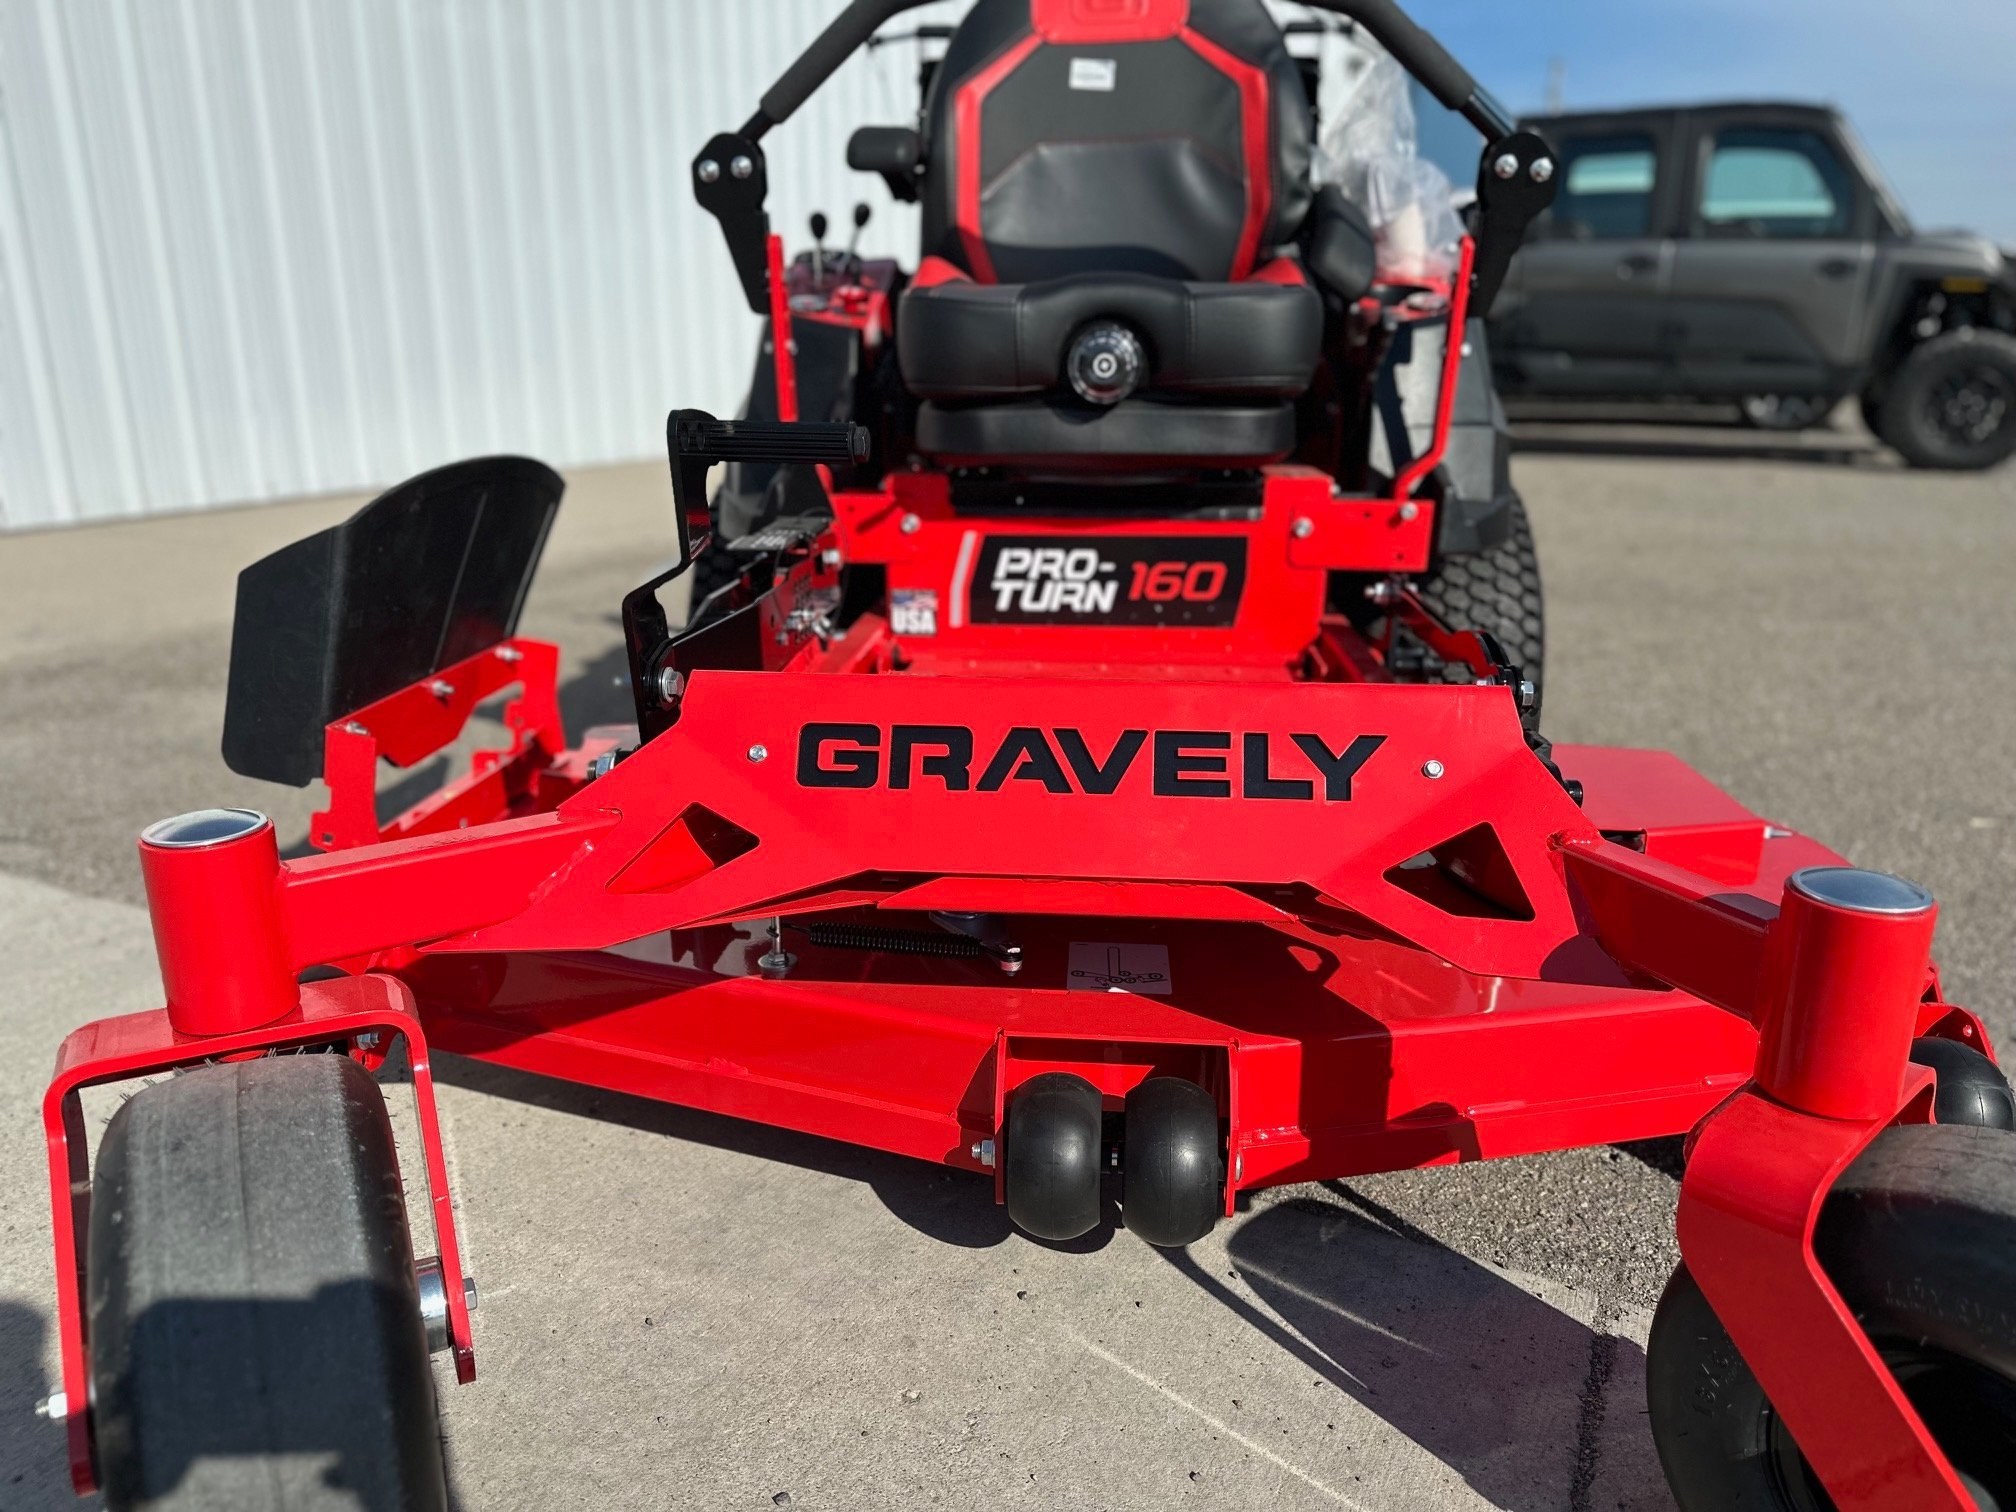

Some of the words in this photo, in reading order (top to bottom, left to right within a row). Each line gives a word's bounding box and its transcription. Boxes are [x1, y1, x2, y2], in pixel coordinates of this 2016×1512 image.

[994, 548, 1116, 580] PRO-
[991, 580, 1119, 613] TURN
[1128, 561, 1227, 601] 160
[891, 607, 936, 635] USA
[796, 722, 1388, 802] GRAVELY
